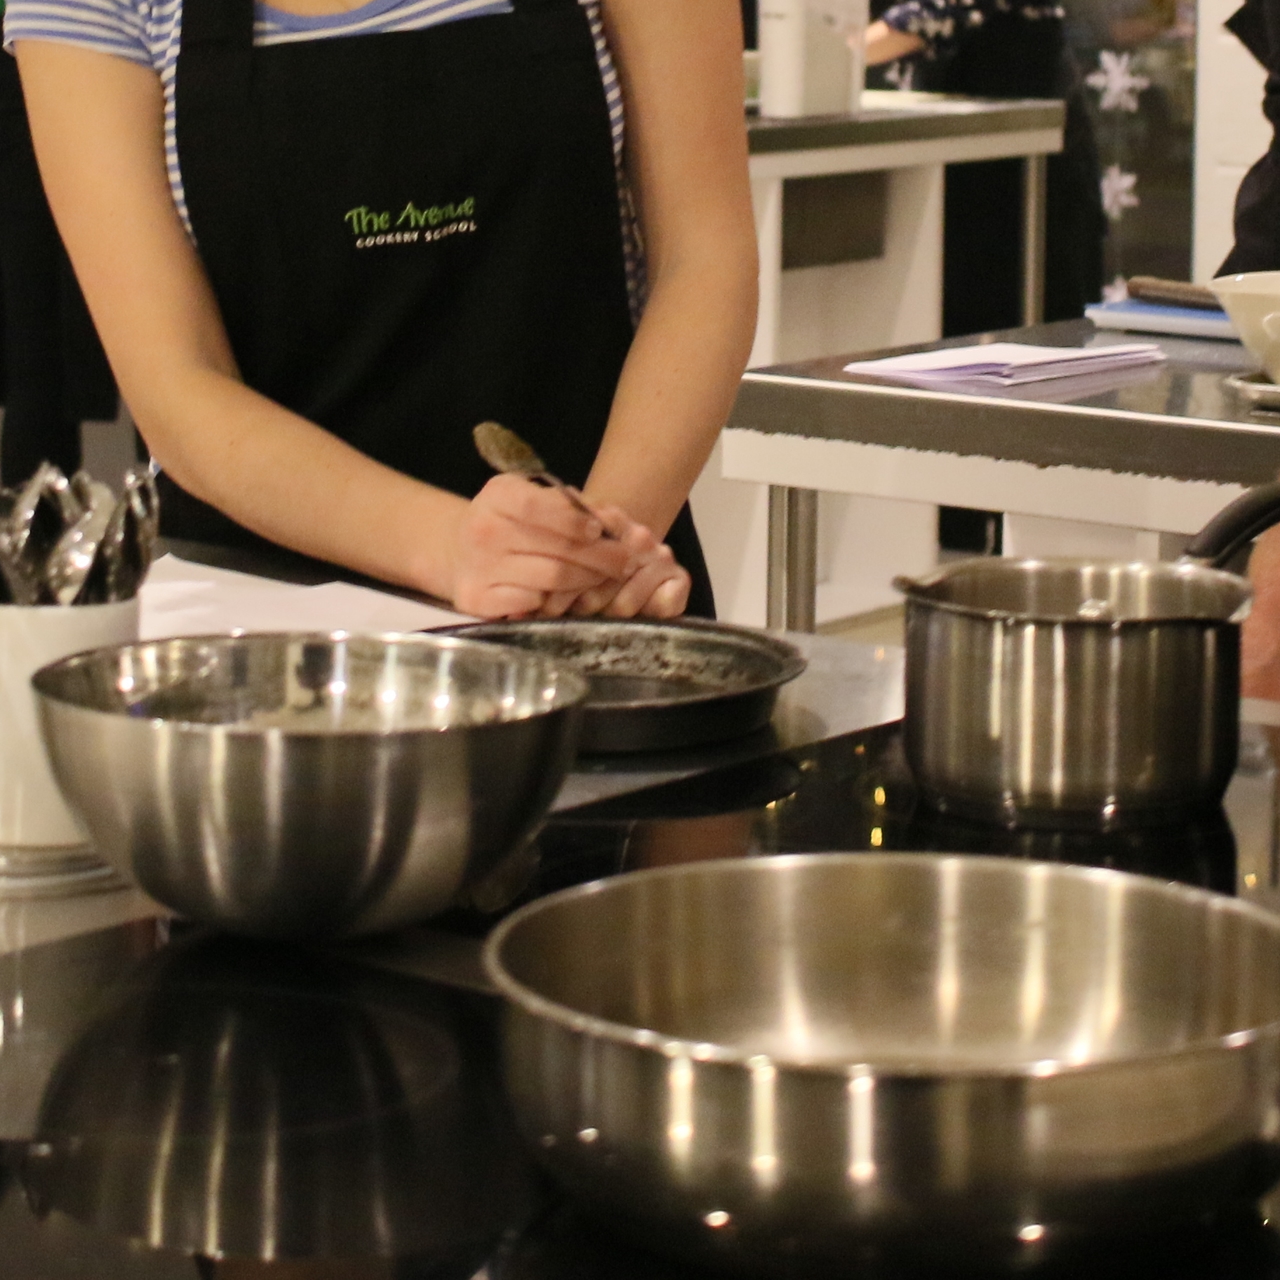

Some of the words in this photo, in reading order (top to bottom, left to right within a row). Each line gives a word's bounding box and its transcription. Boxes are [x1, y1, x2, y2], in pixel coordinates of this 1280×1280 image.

[344, 206, 390, 234] The
[396, 196, 475, 227] Avenue
[356, 231, 419, 248] COOKERY
[424, 220, 477, 242] SCHOOL
